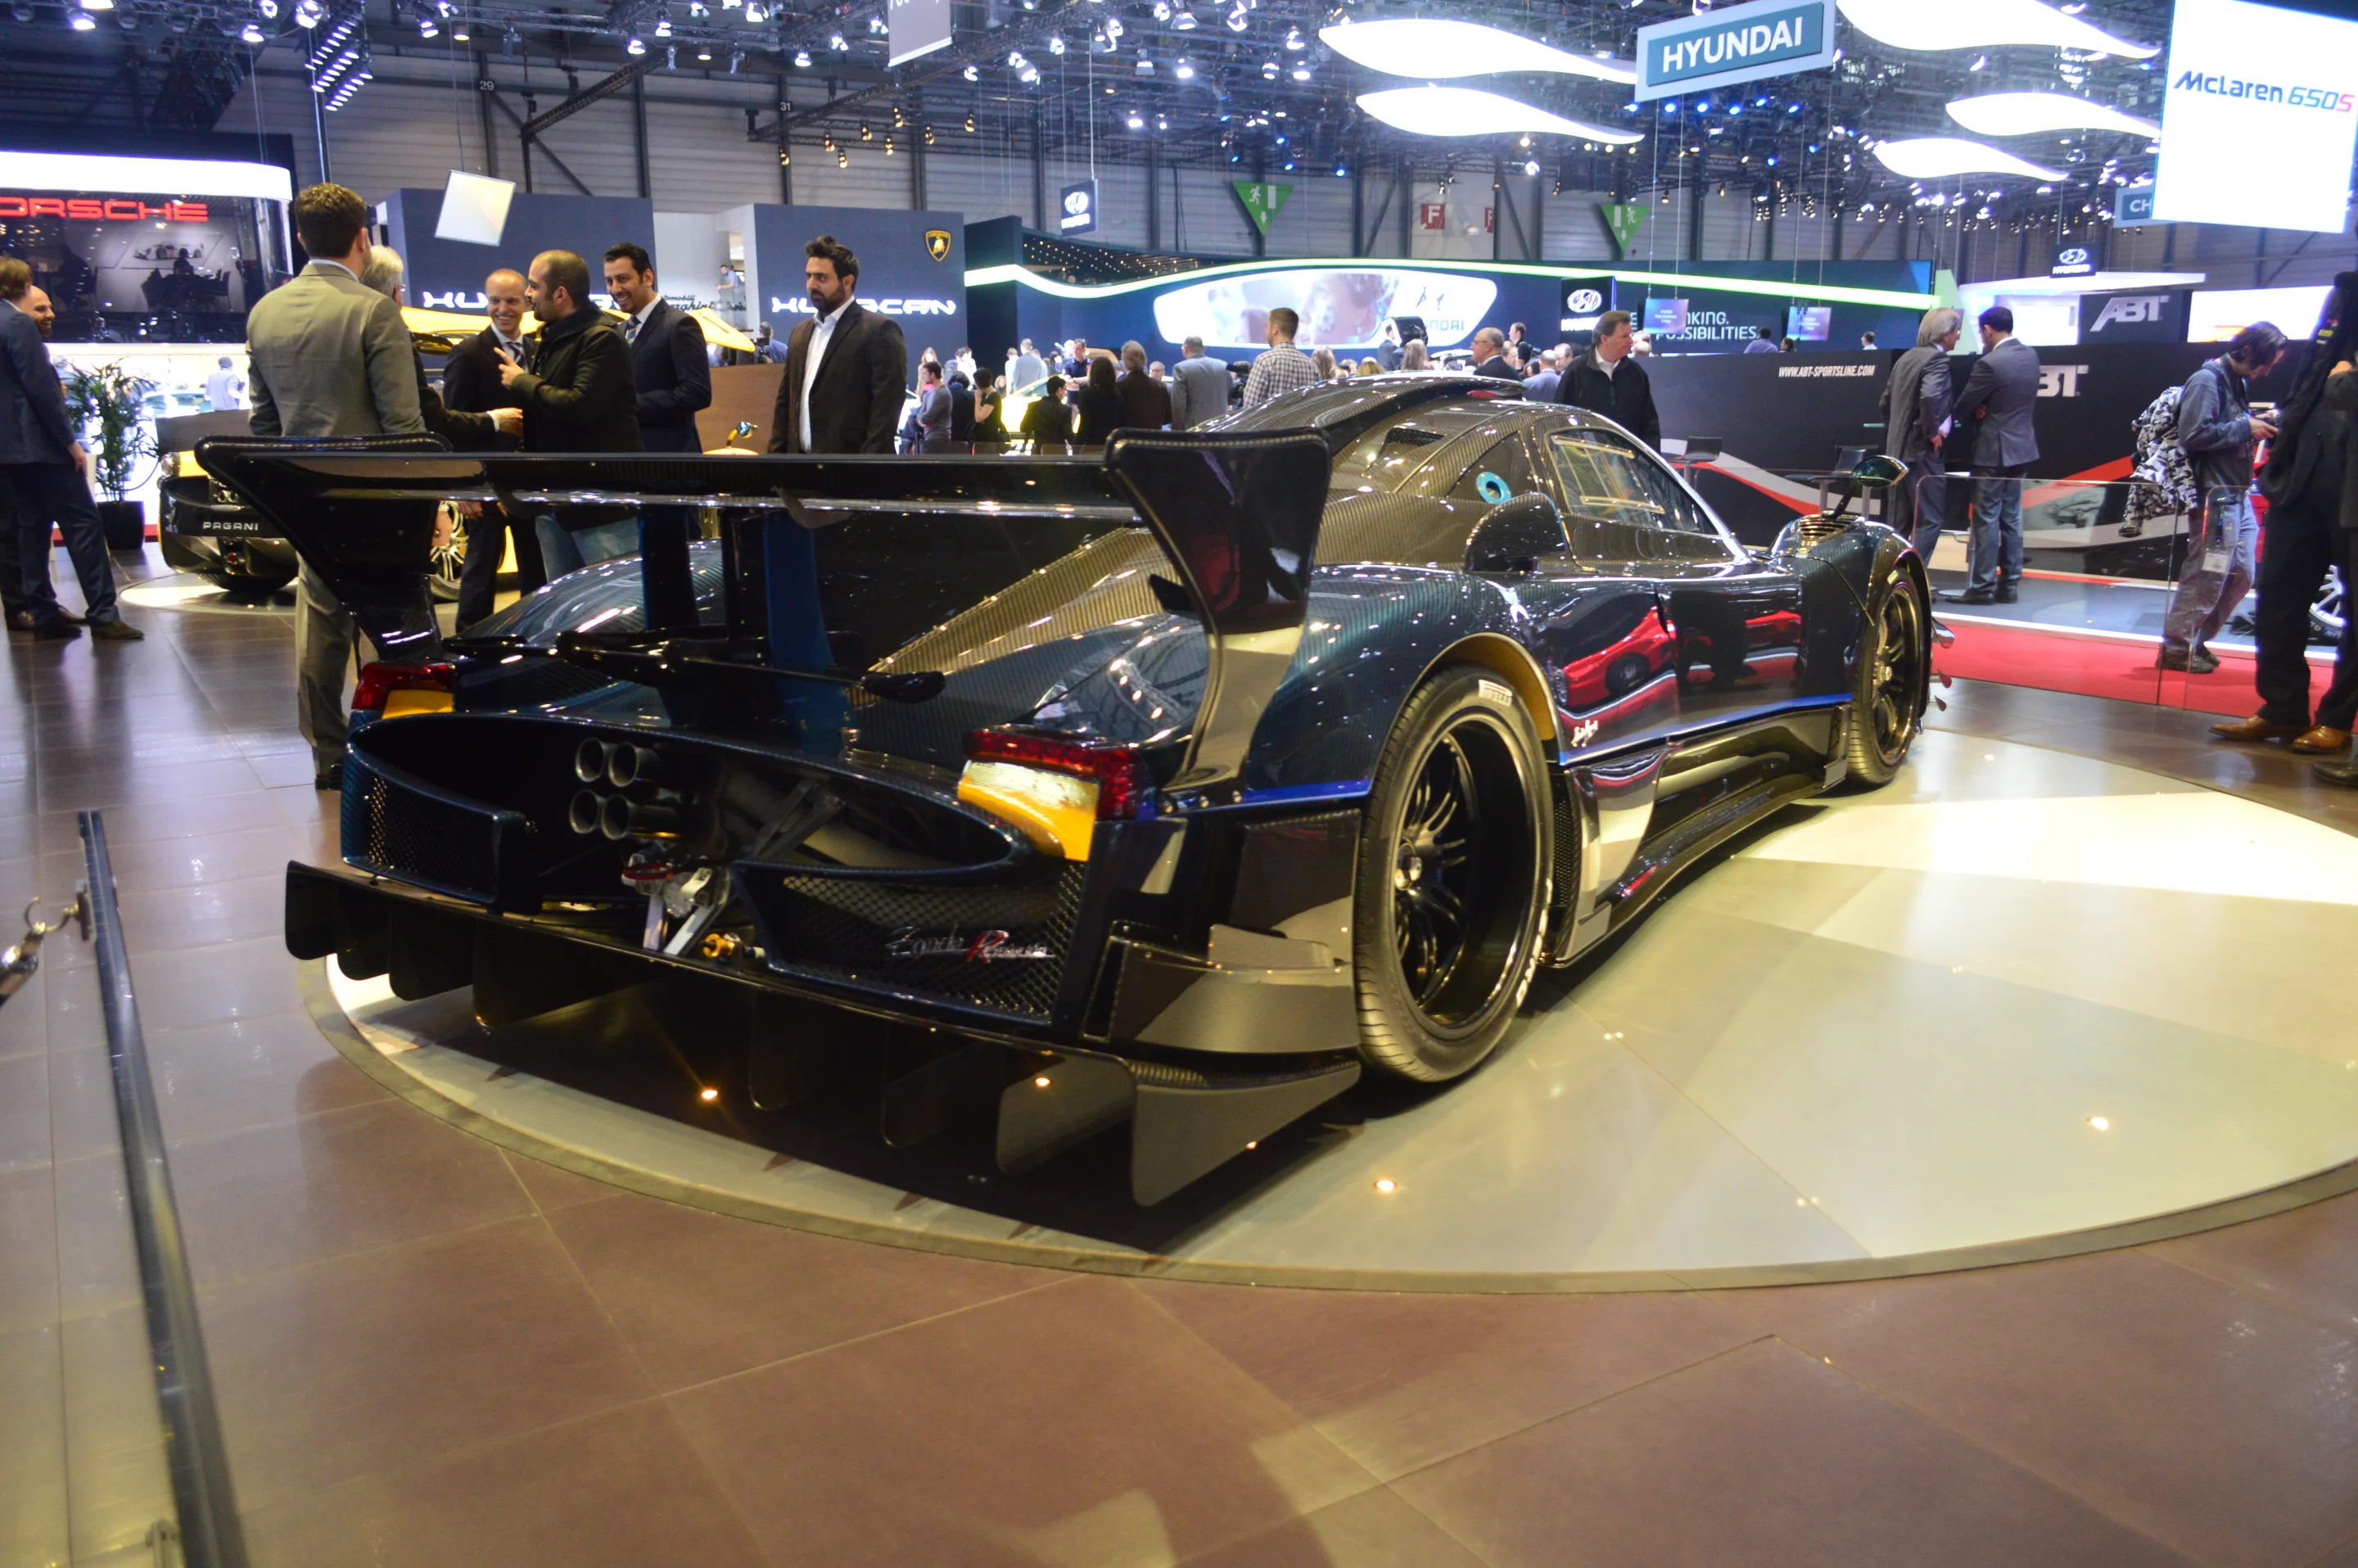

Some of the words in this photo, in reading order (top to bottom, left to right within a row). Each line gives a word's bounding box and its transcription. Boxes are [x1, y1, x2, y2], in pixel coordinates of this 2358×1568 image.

[1663, 16, 1803, 73] HYUNDAI
[479, 80, 495, 91] 29
[2173, 70, 2283, 103] McLaren
[2288, 86, 2355, 112] 650S
[780, 102, 791, 111] 31
[0, 197, 209, 222] ORSCHE
[1428, 205, 1441, 224] F
[2130, 199, 2152, 213] CH
[771, 297, 956, 314] HUACAN
[2089, 295, 2170, 332] ABT
[1778, 365, 1876, 377] WWW.ABT-SPORTSLINE.COM
[2037, 365, 2089, 397] BT
[203, 522, 259, 531] PAGANI
